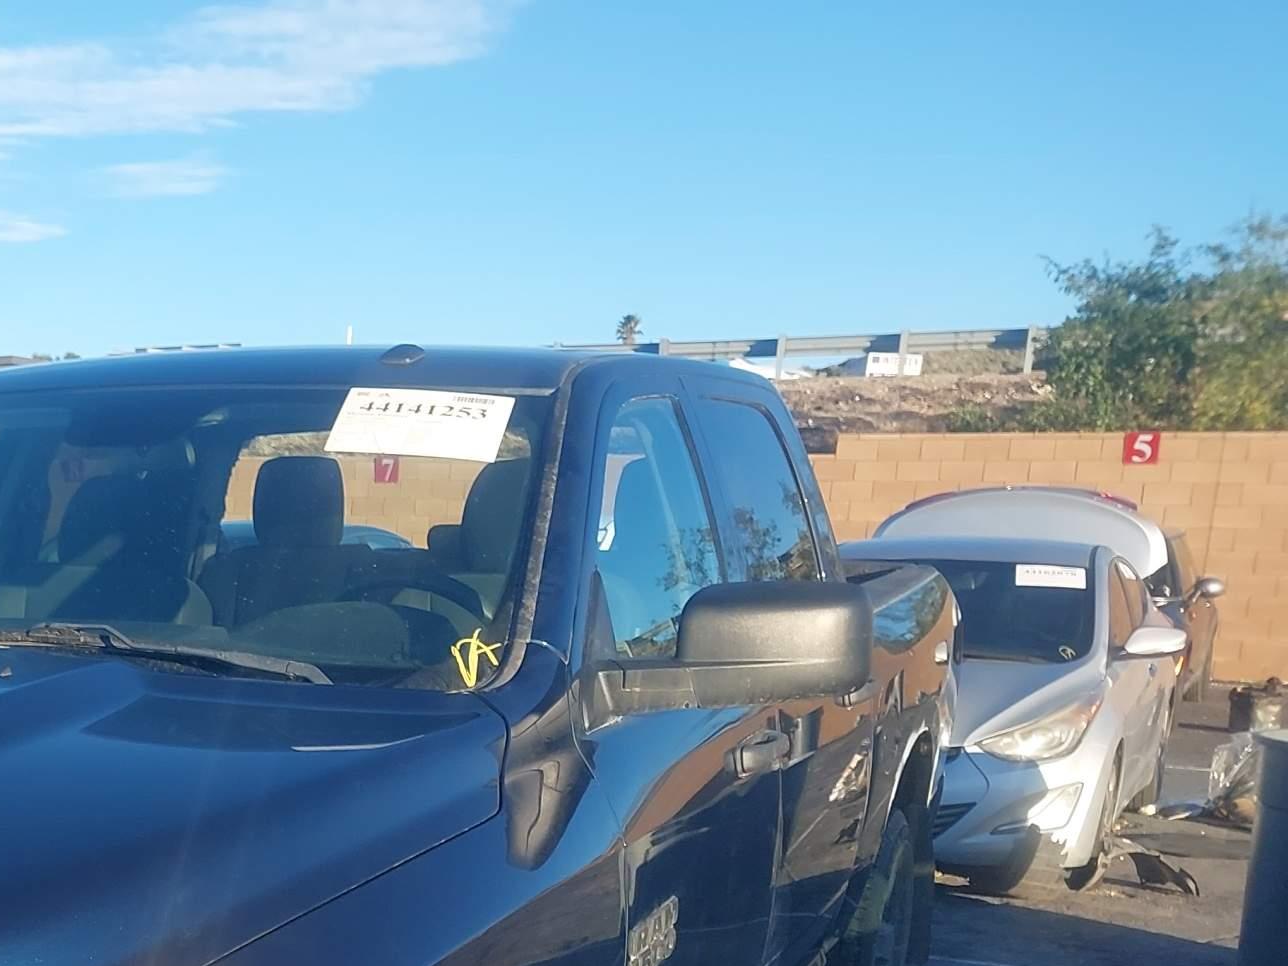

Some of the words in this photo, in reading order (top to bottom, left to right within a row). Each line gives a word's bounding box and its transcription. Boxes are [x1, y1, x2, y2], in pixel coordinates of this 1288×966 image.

[359, 400, 489, 420] 44141253
[1131, 434, 1153, 462] 5
[382, 459, 394, 482] 7
